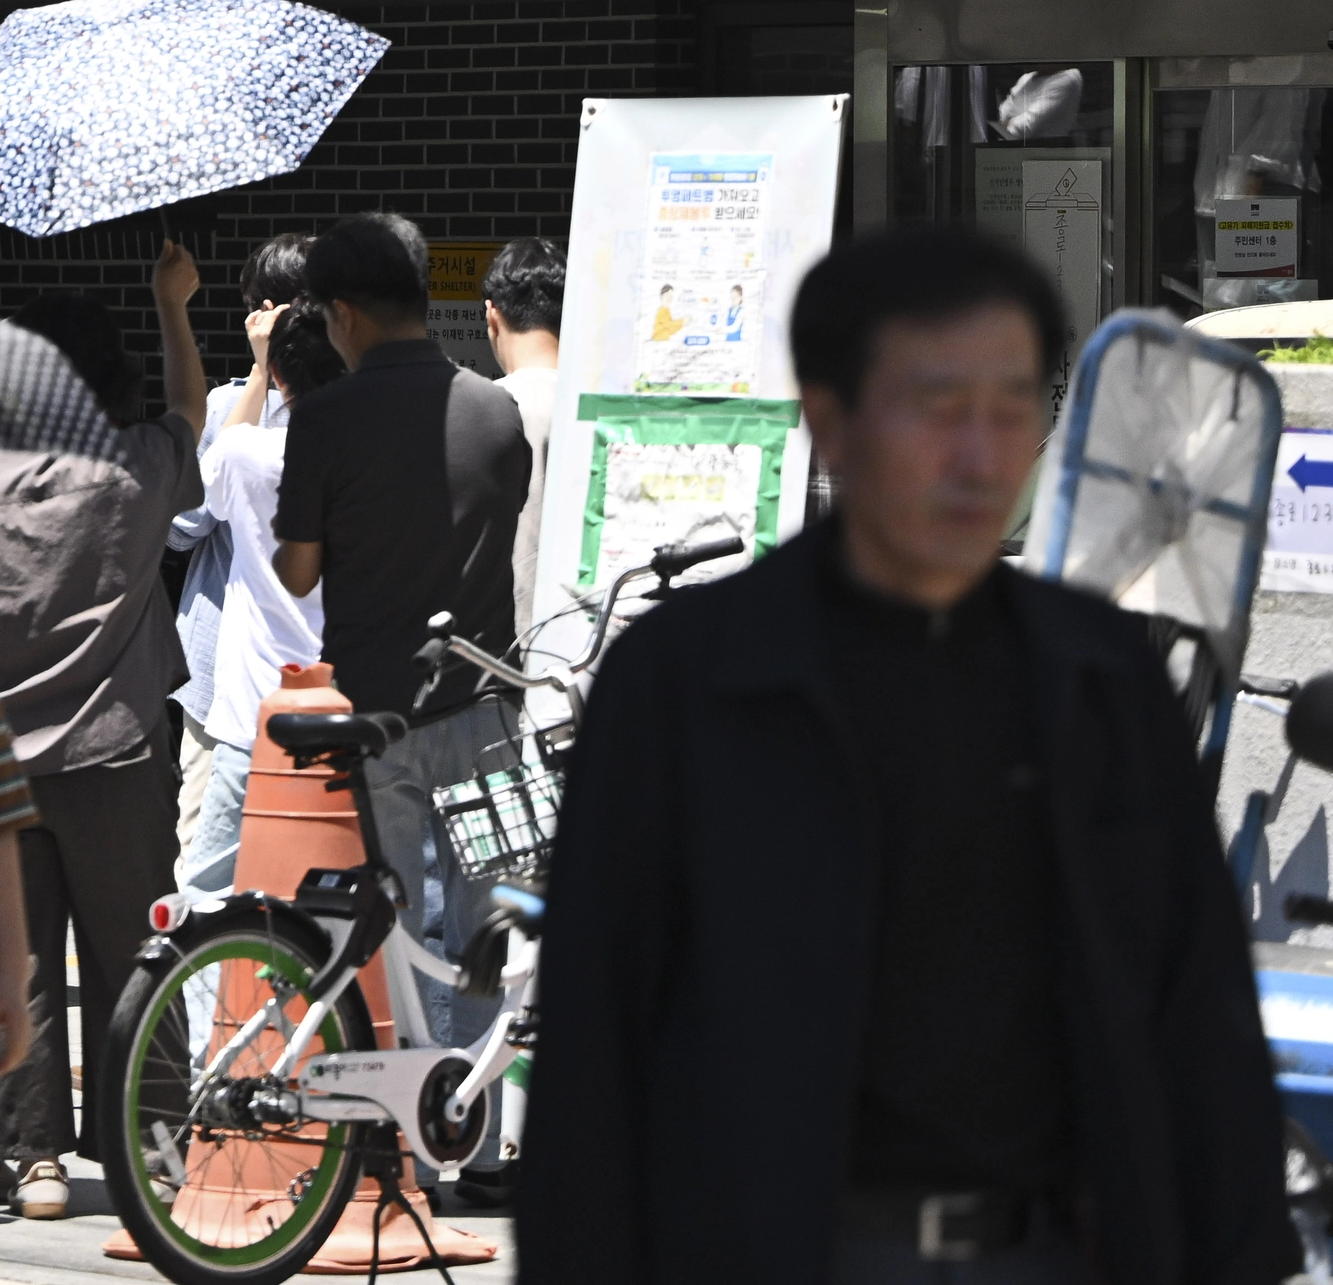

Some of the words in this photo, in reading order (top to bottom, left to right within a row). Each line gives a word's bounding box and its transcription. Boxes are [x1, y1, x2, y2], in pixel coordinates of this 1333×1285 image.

[718, 189, 759, 202] 가져오고
[1234, 236, 1262, 246] 주민센터
[1266, 236, 1276, 246] 1층
[428, 256, 476, 276] 주거시설
[440, 281, 476, 292] SHELTER)
[444, 308, 459, 321] 각종
[461, 309, 476, 321] 재난
[442, 328, 464, 340] 이재민
